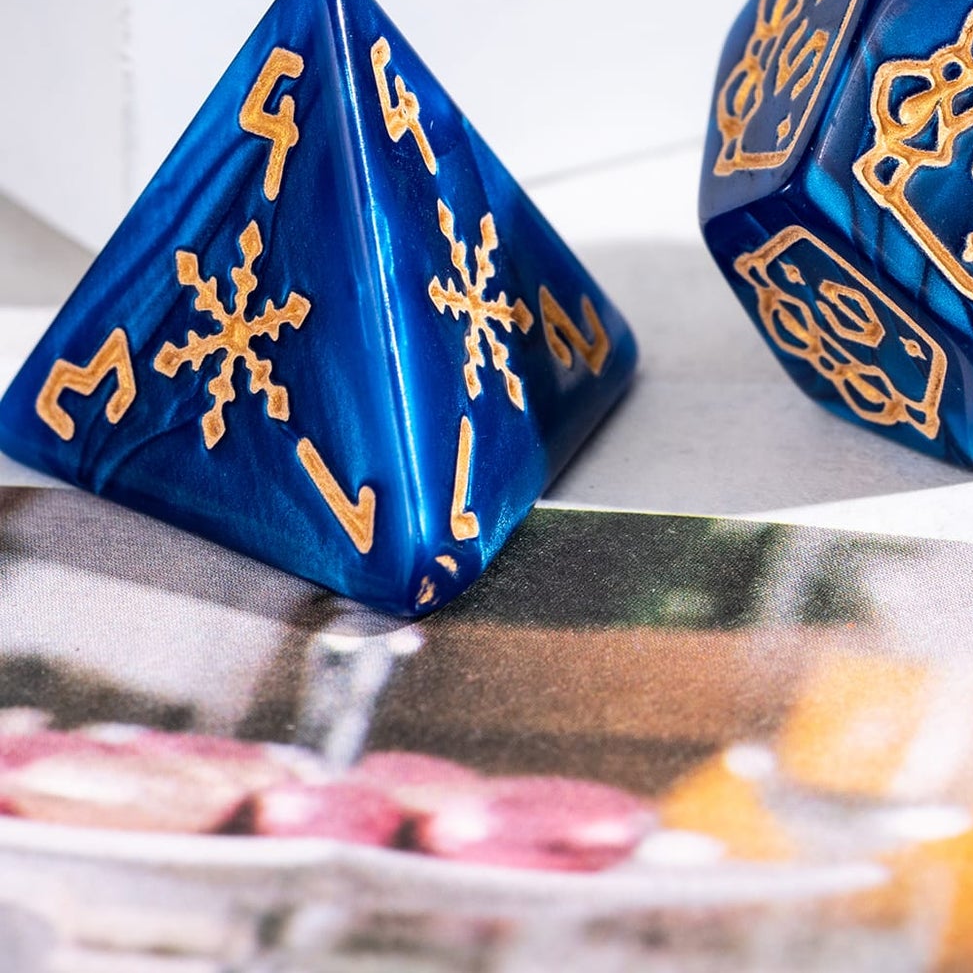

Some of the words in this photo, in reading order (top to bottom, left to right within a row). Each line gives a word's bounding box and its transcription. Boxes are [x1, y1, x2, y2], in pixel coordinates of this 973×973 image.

[240, 47, 305, 201] 4
[370, 37, 436, 175] 4
[35, 328, 138, 441] 3
